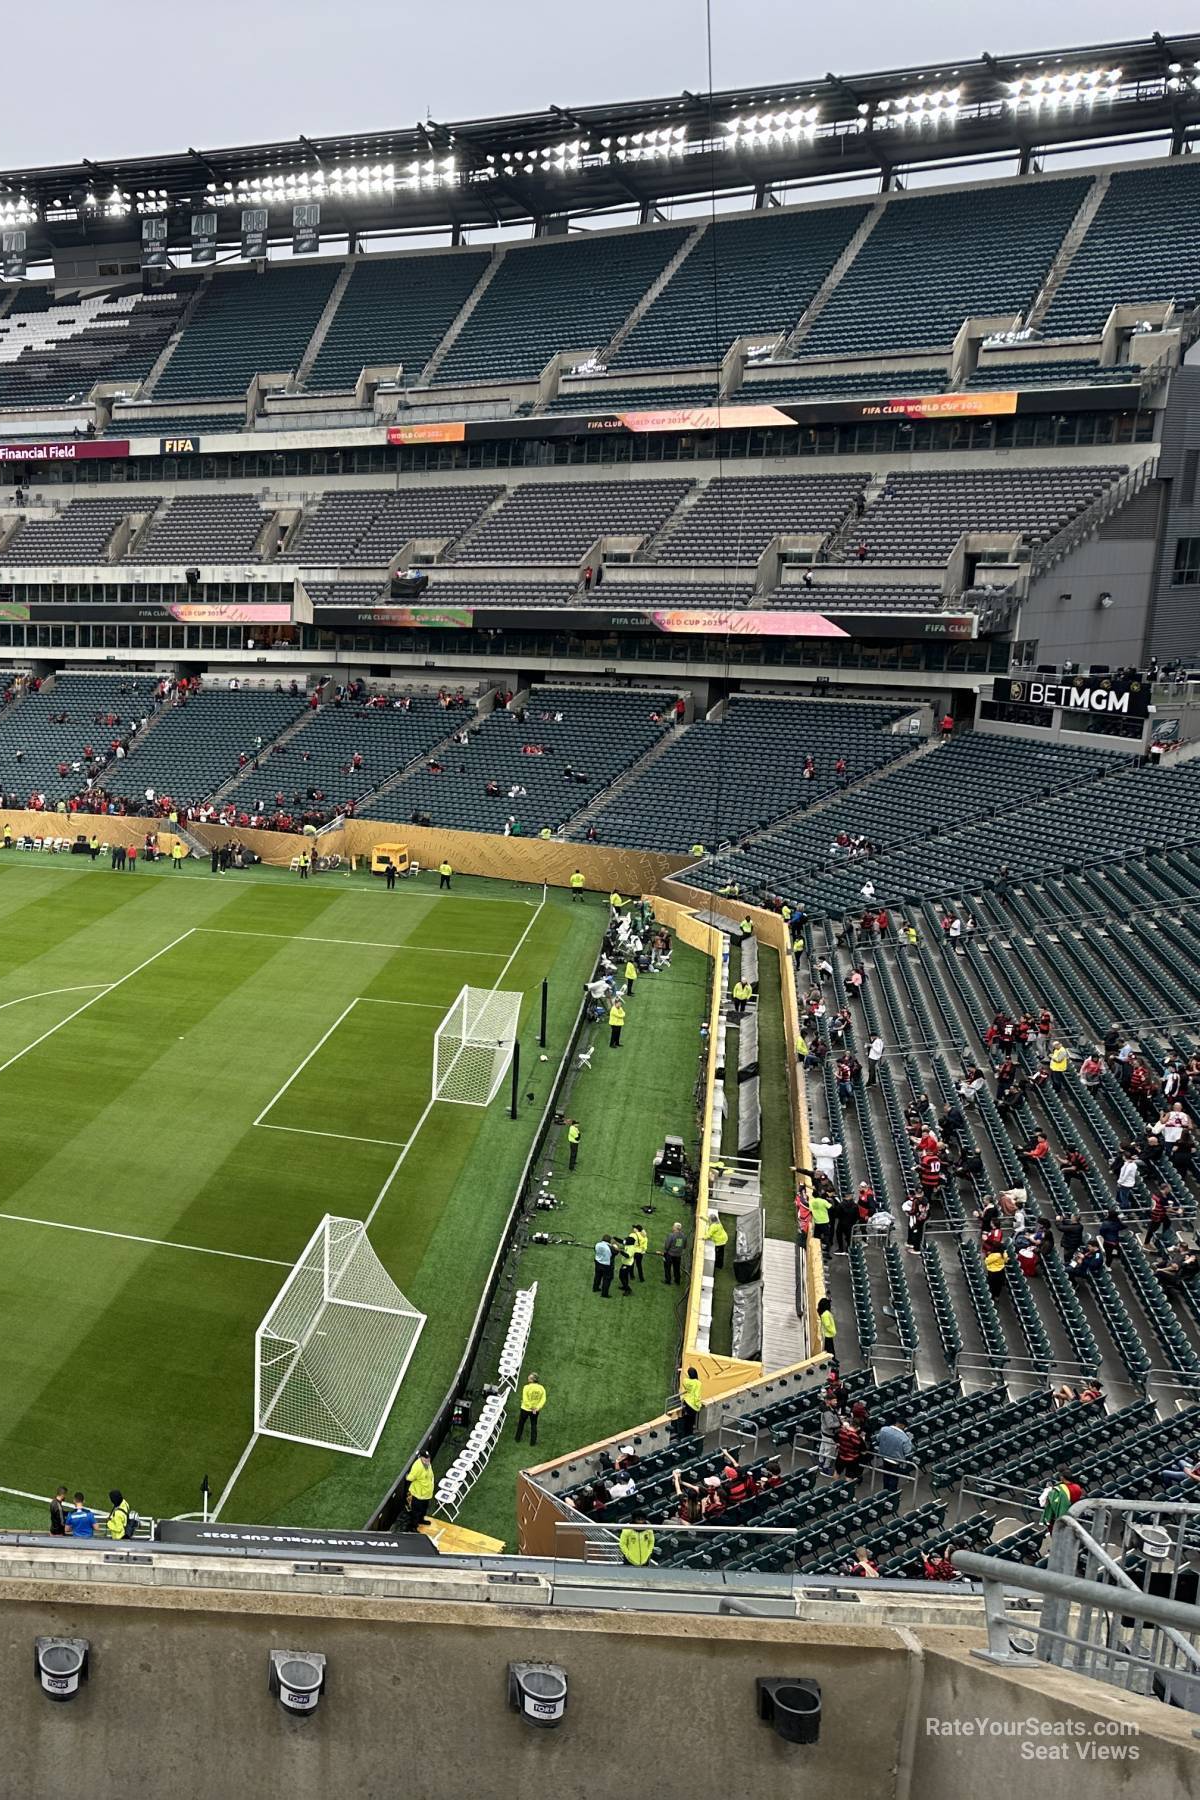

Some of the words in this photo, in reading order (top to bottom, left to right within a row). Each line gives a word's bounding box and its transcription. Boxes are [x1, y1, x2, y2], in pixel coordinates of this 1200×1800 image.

[296, 205, 319, 228] 20
[193, 214, 215, 236] 40
[145, 220, 166, 240] 15
[882, 405, 905, 413] CLUB
[907, 404, 939, 412] WORLD
[164, 439, 195, 453] FIFA
[0, 447, 48, 460] Financial
[49, 445, 76, 458] Field
[611, 617, 628, 625] FIFA
[630, 617, 650, 625] CLUB
[925, 623, 946, 632] FIFA
[1029, 682, 1130, 713] BETMGM
[272, 1536, 326, 1545] WORLD
[327, 1539, 366, 1547] CLUB
[368, 1541, 399, 1549] FIFA
[48, 1680, 68, 1689] TORK
[289, 1695, 309, 1704] TORK
[534, 1704, 556, 1713] TORK
